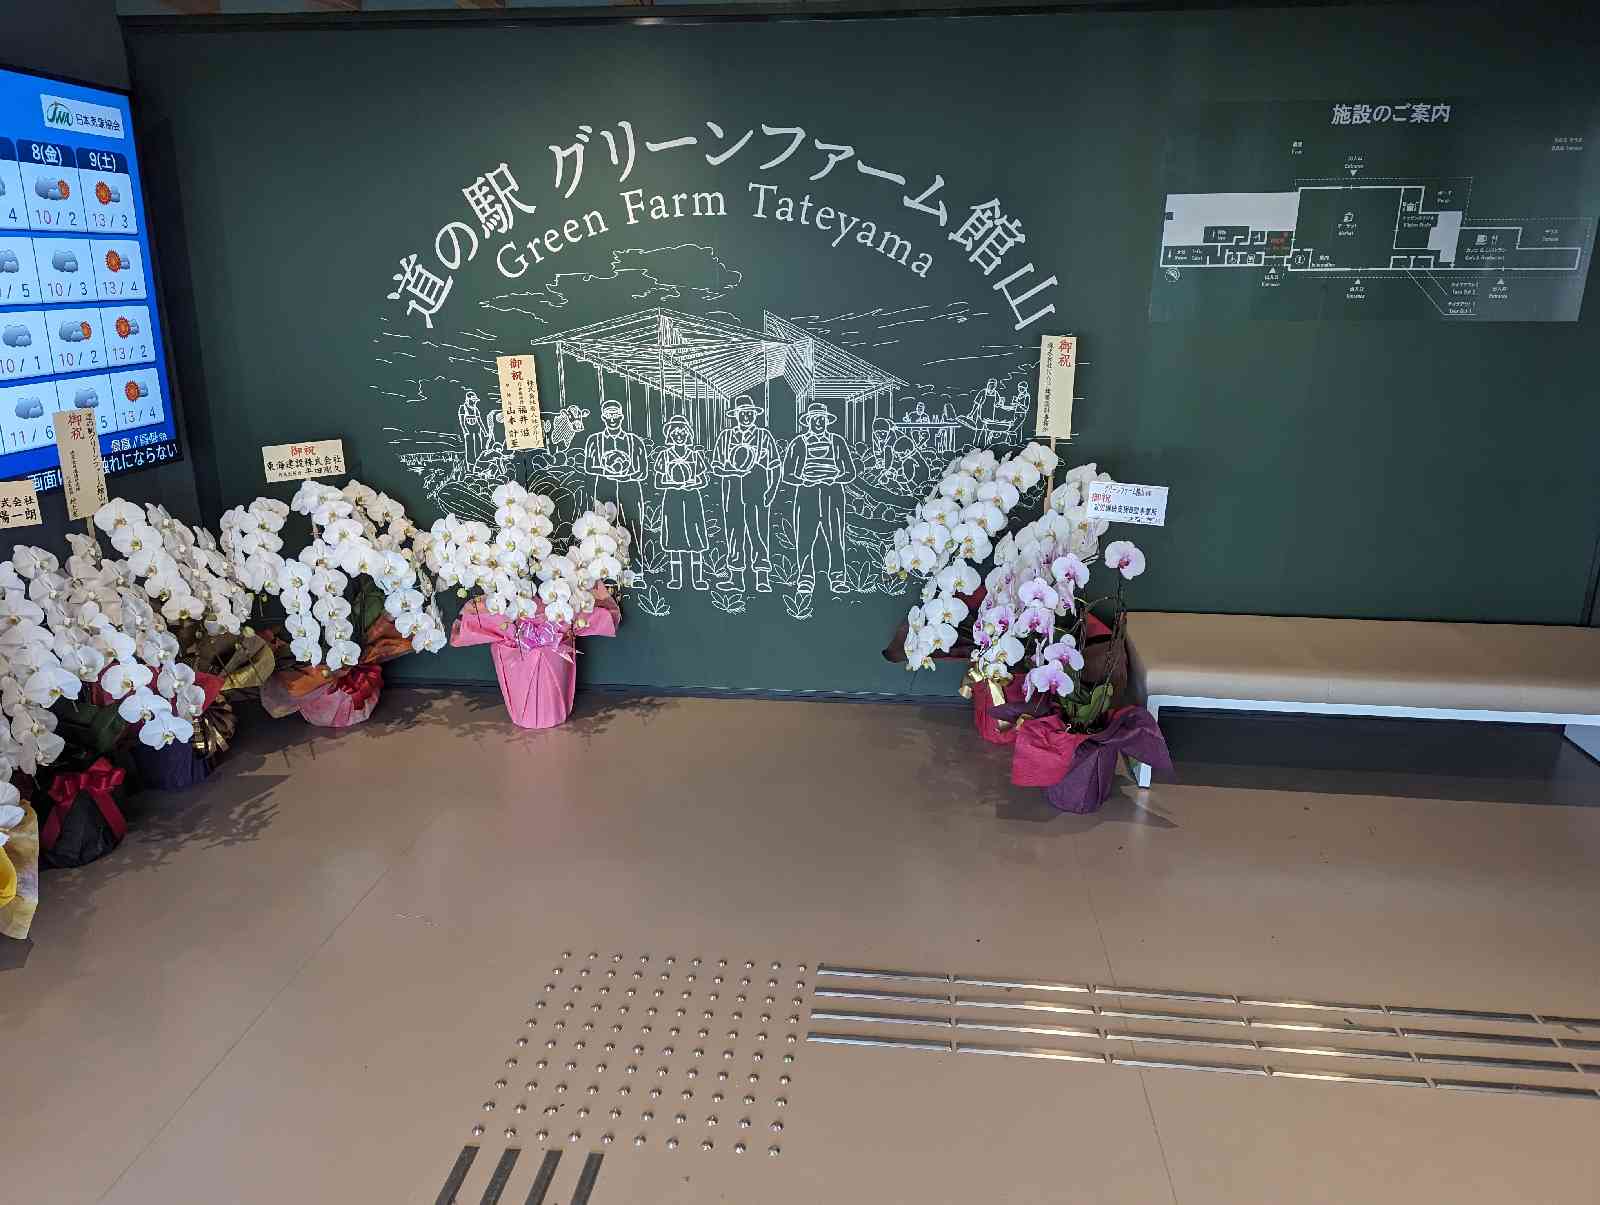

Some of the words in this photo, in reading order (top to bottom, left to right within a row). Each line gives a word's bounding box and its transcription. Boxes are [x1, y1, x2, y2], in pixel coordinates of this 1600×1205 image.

[1331, 103, 1451, 126] 施設のご案内
[31, 143, 62, 166] 8(金)
[89, 151, 116, 172] 9(土)
[496, 209, 608, 279] Green
[619, 188, 727, 225] Farm
[748, 182, 933, 278] Tateyama
[1057, 340, 1073, 368] 御祝
[68, 415, 85, 440] 御祝
